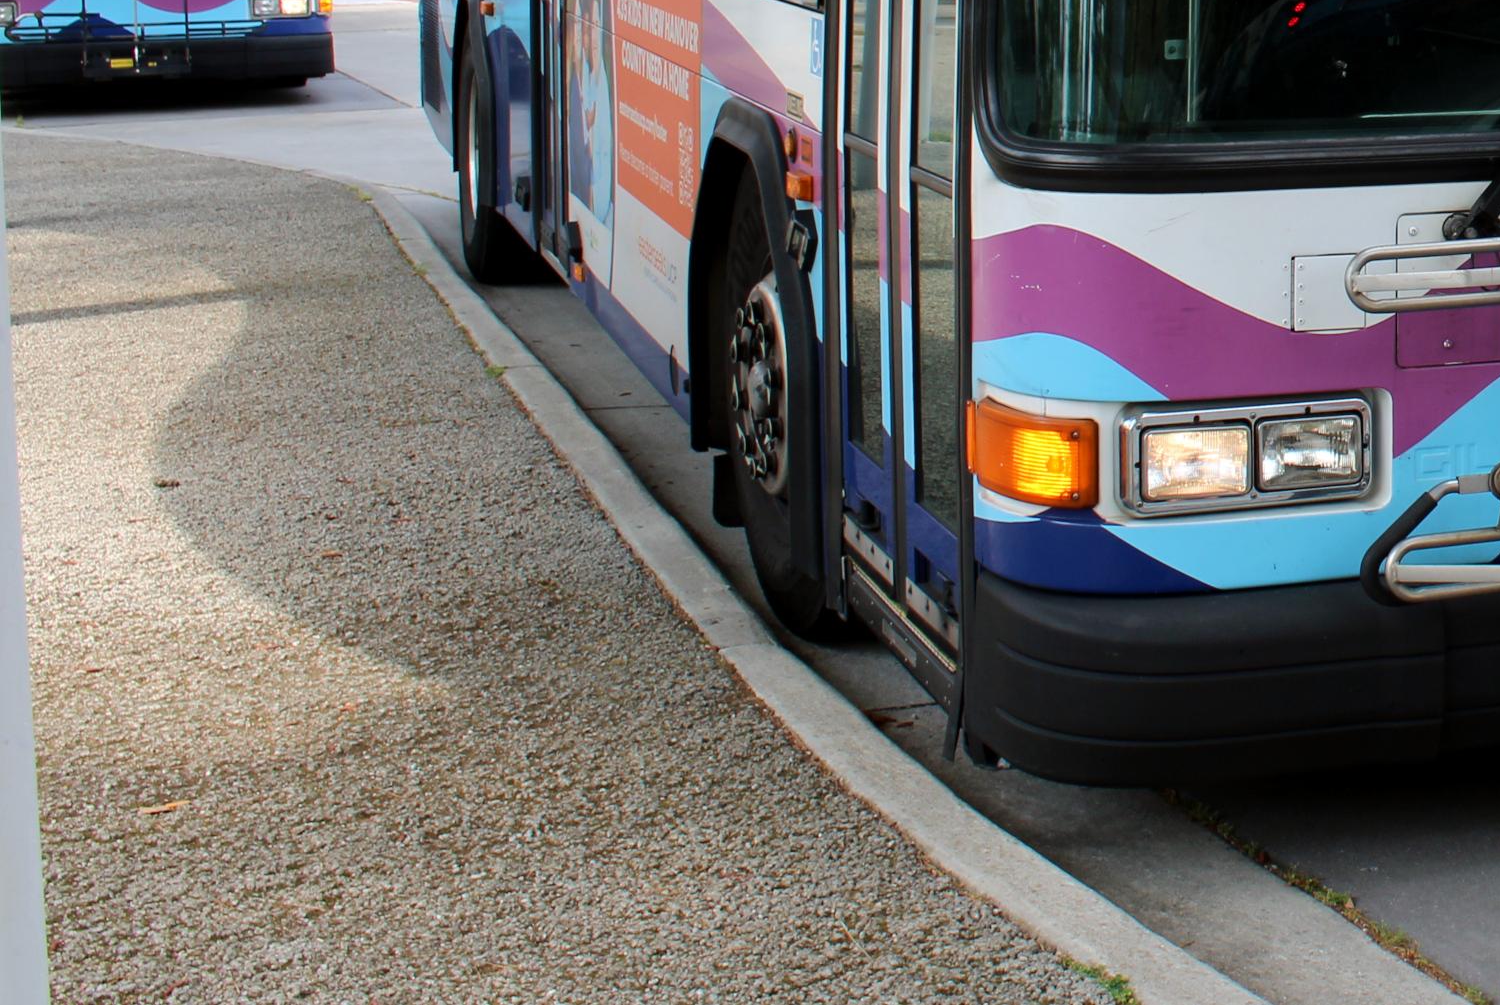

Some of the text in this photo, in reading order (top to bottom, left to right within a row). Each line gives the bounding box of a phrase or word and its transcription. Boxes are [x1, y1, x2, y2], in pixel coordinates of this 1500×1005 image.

[649, 5, 665, 38] NEW
[664, 10, 699, 54] HANOVER
[621, 40, 647, 78] COUNTY
[646, 51, 662, 87] NEED
[668, 63, 690, 101] HOME
